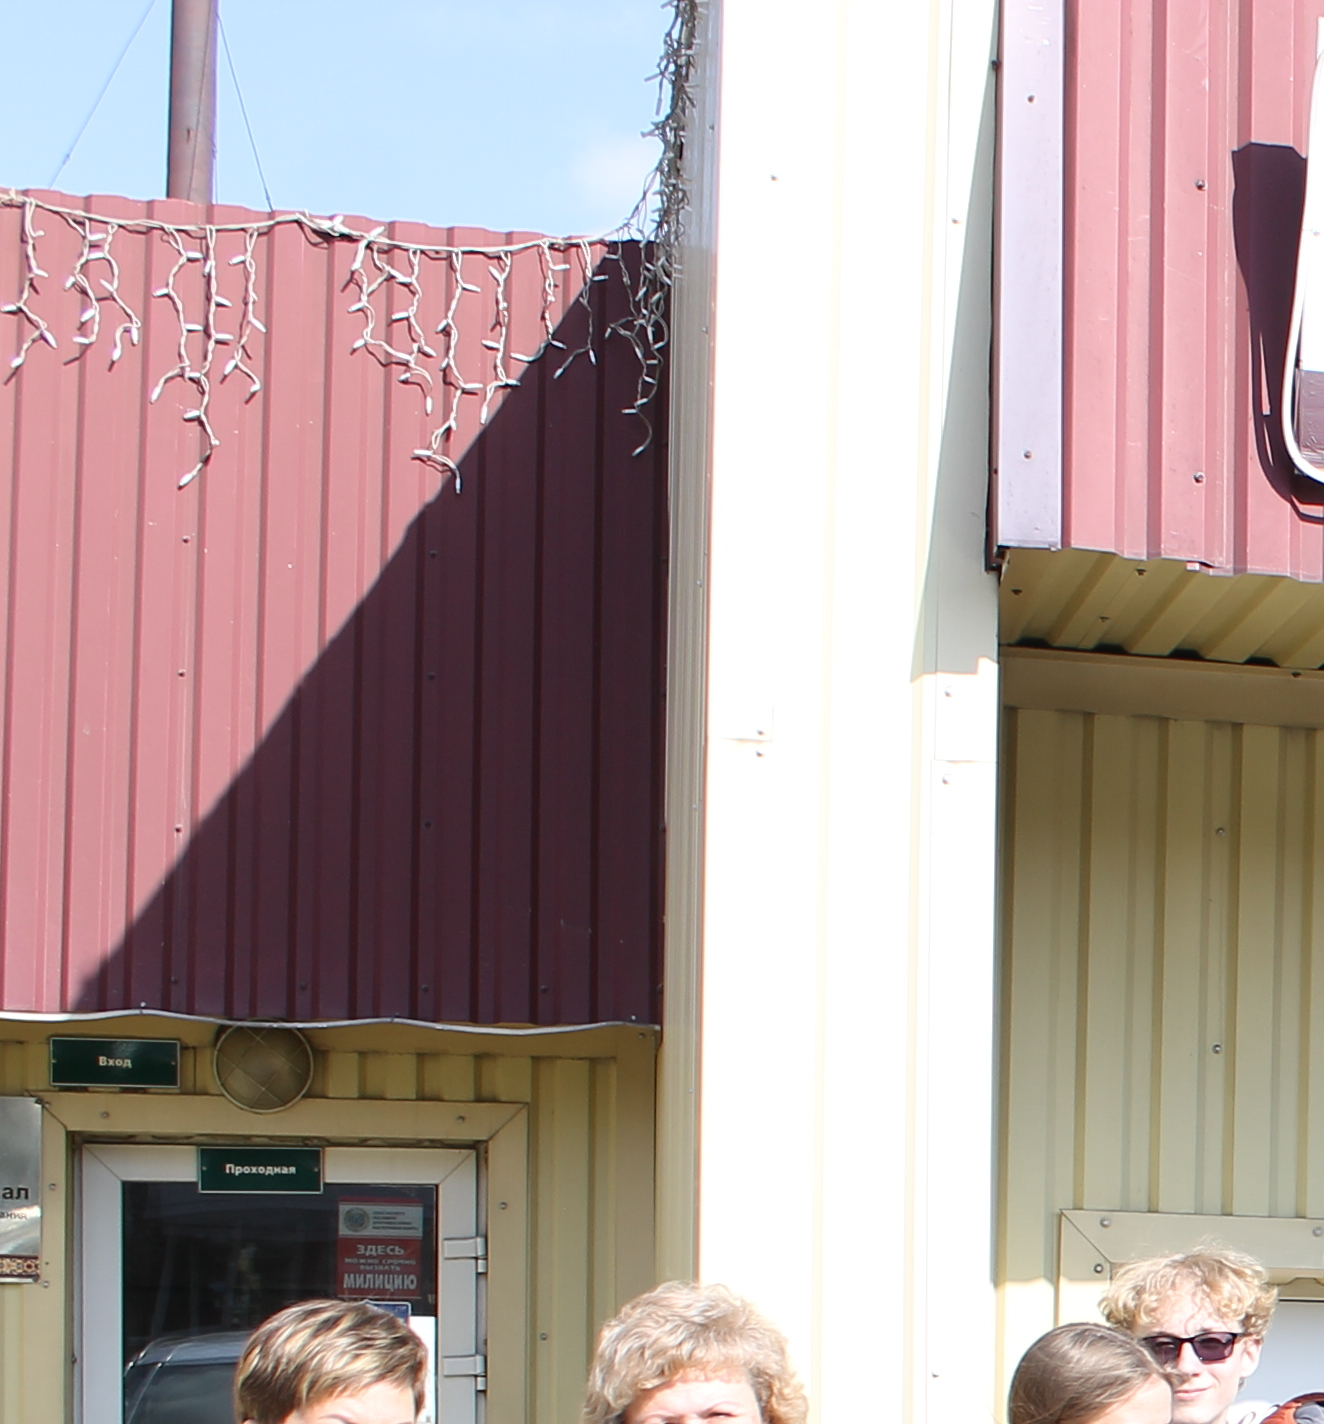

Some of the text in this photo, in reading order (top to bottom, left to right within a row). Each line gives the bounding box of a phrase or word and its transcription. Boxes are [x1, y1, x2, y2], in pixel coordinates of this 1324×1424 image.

[98, 1055, 132, 1069] Вход
[225, 1163, 297, 1176] Проходная
[1, 1186, 29, 1200] ал
[356, 1244, 405, 1256] ЗДЕСЬ
[343, 1273, 417, 1291] МИЛИЦИЮ
